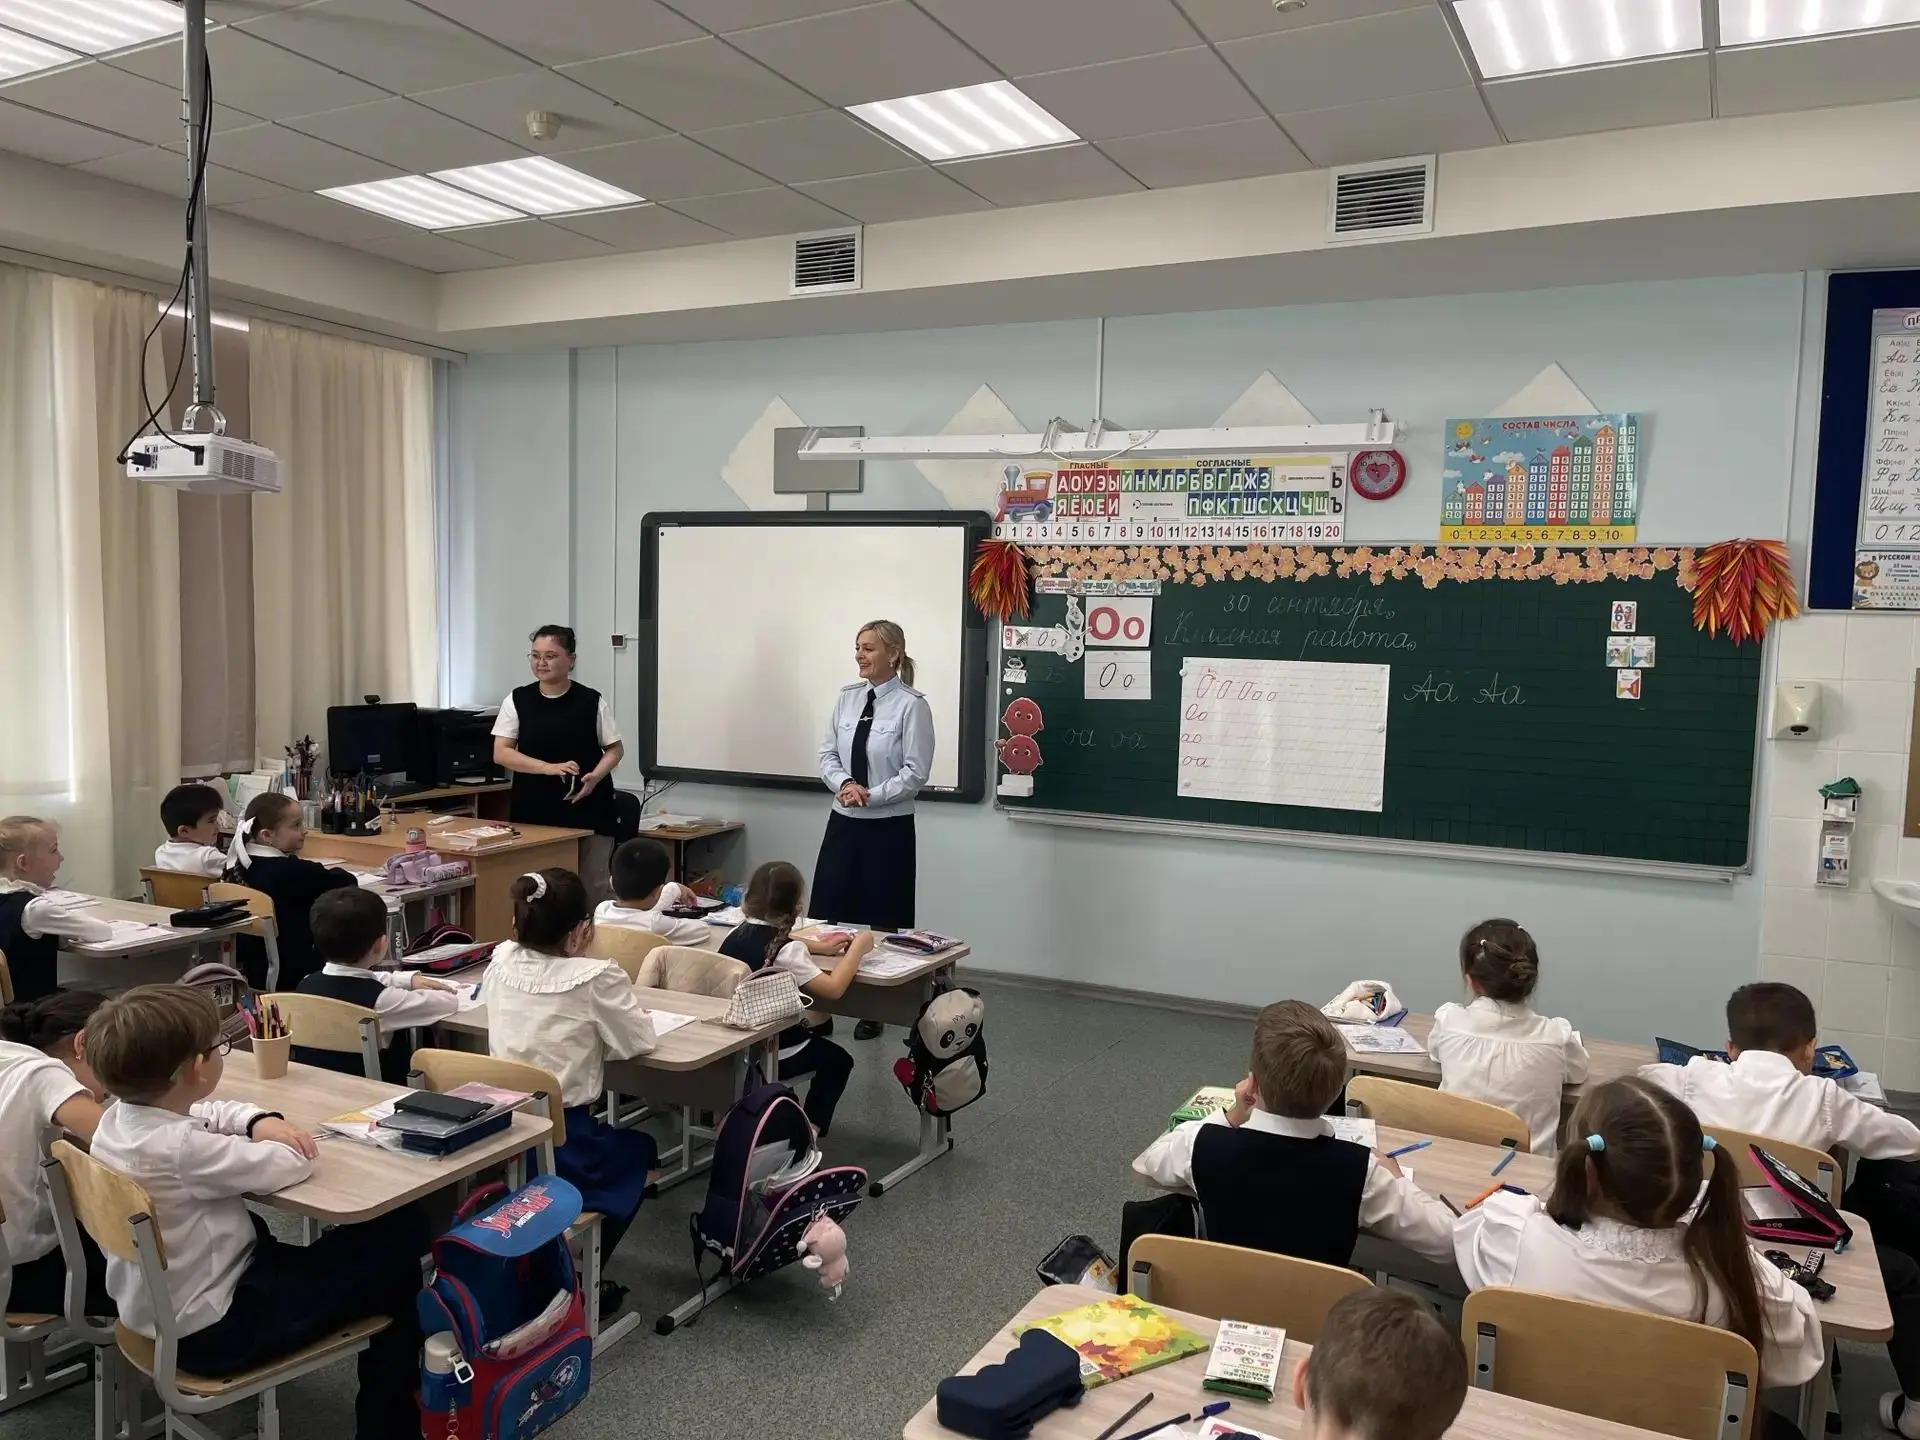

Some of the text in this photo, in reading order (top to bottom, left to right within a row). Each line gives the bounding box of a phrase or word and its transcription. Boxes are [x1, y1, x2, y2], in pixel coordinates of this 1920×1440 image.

[1502, 420, 1576, 430] СОСТАВ ЧИСЛА
[1196, 459, 1251, 467] СОГЛАСНЫЕ
[995, 526, 1340, 537] 0 1 2 3 4 5 6 7 8 9 10 11 12 13 14 15 16 17 18 19 20
[1452, 530, 1620, 540] 0 1 2 3 4 5 6 7 8 9 10
[1876, 525, 1920, 540] 0 1 2
[1223, 594, 1250, 613] 30
